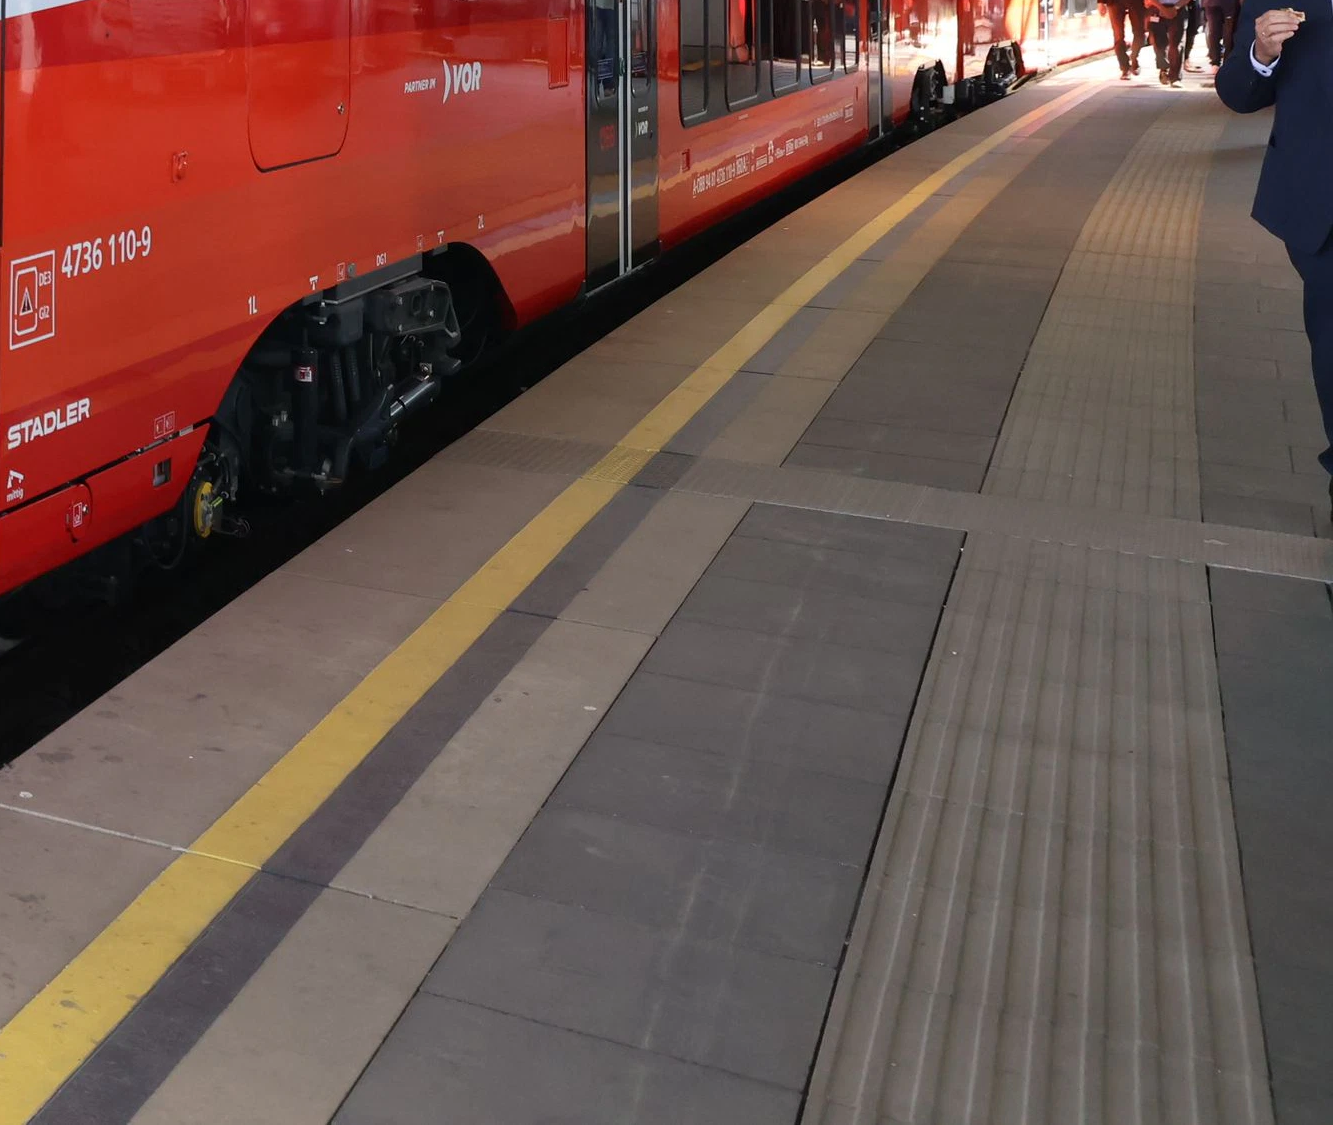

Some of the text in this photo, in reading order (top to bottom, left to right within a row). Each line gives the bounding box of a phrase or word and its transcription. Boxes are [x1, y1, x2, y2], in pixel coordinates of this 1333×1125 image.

[453, 61, 482, 94] VOR
[62, 226, 151, 279] 4736 110-9
[8, 398, 90, 450] STADLER
